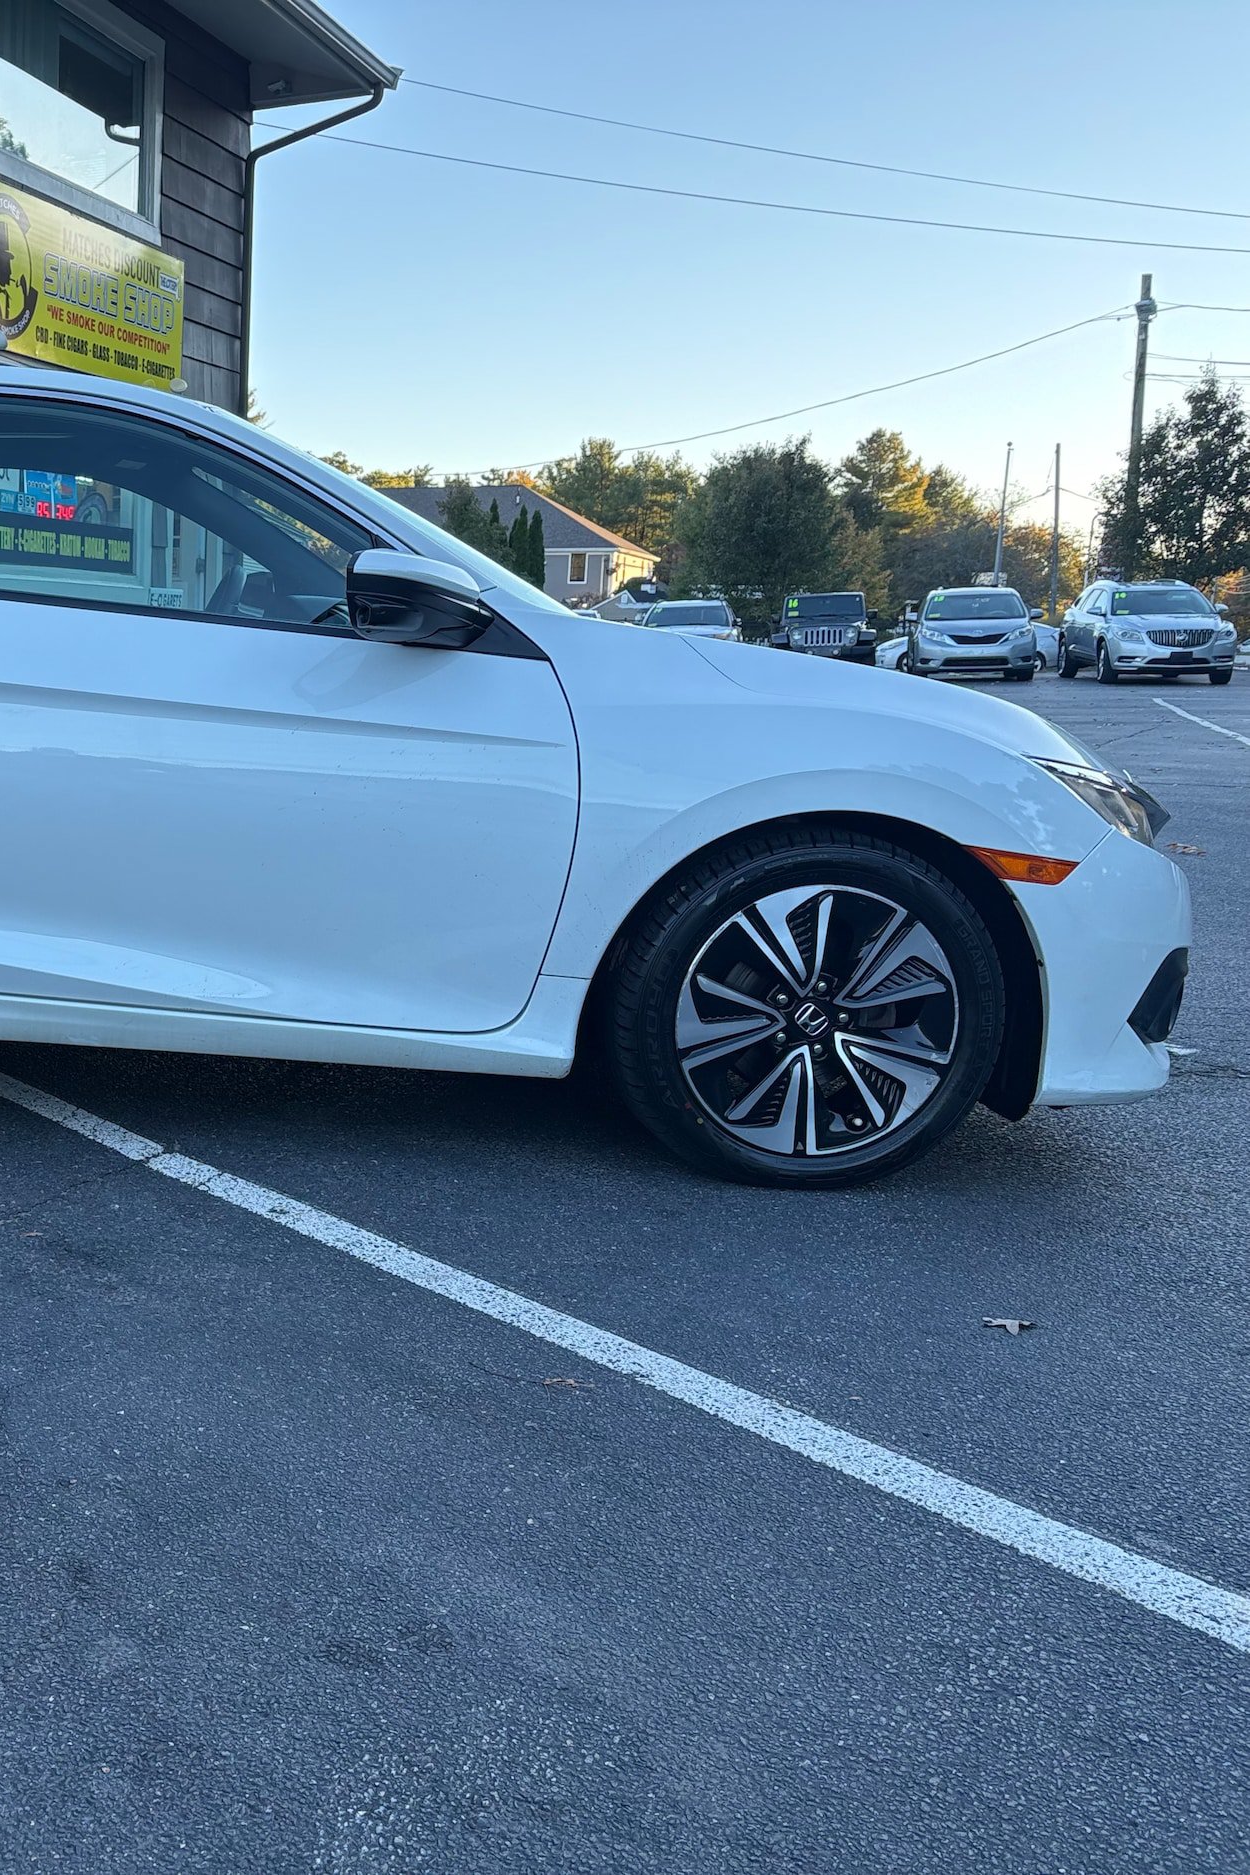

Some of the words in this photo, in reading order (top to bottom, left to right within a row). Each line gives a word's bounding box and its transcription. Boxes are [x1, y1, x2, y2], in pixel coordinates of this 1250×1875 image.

[63, 227, 111, 269] MATCHES
[114, 248, 161, 288] DISCOUNT
[44, 250, 119, 318] SMOKE
[124, 282, 174, 336] SHOP
[35, 325, 49, 344] CBD
[53, 331, 66, 350] FINE
[67, 335, 88, 356] CIGARS
[92, 343, 110, 362] GLASS
[114, 349, 139, 371] TOBACCO
[142, 358, 175, 380] E-CIGARETTES
[66, 310, 96, 332] SMOKE
[98, 321, 115, 338] OUR
[788, 599, 798, 608] 16
[958, 925, 991, 985] GRAND
